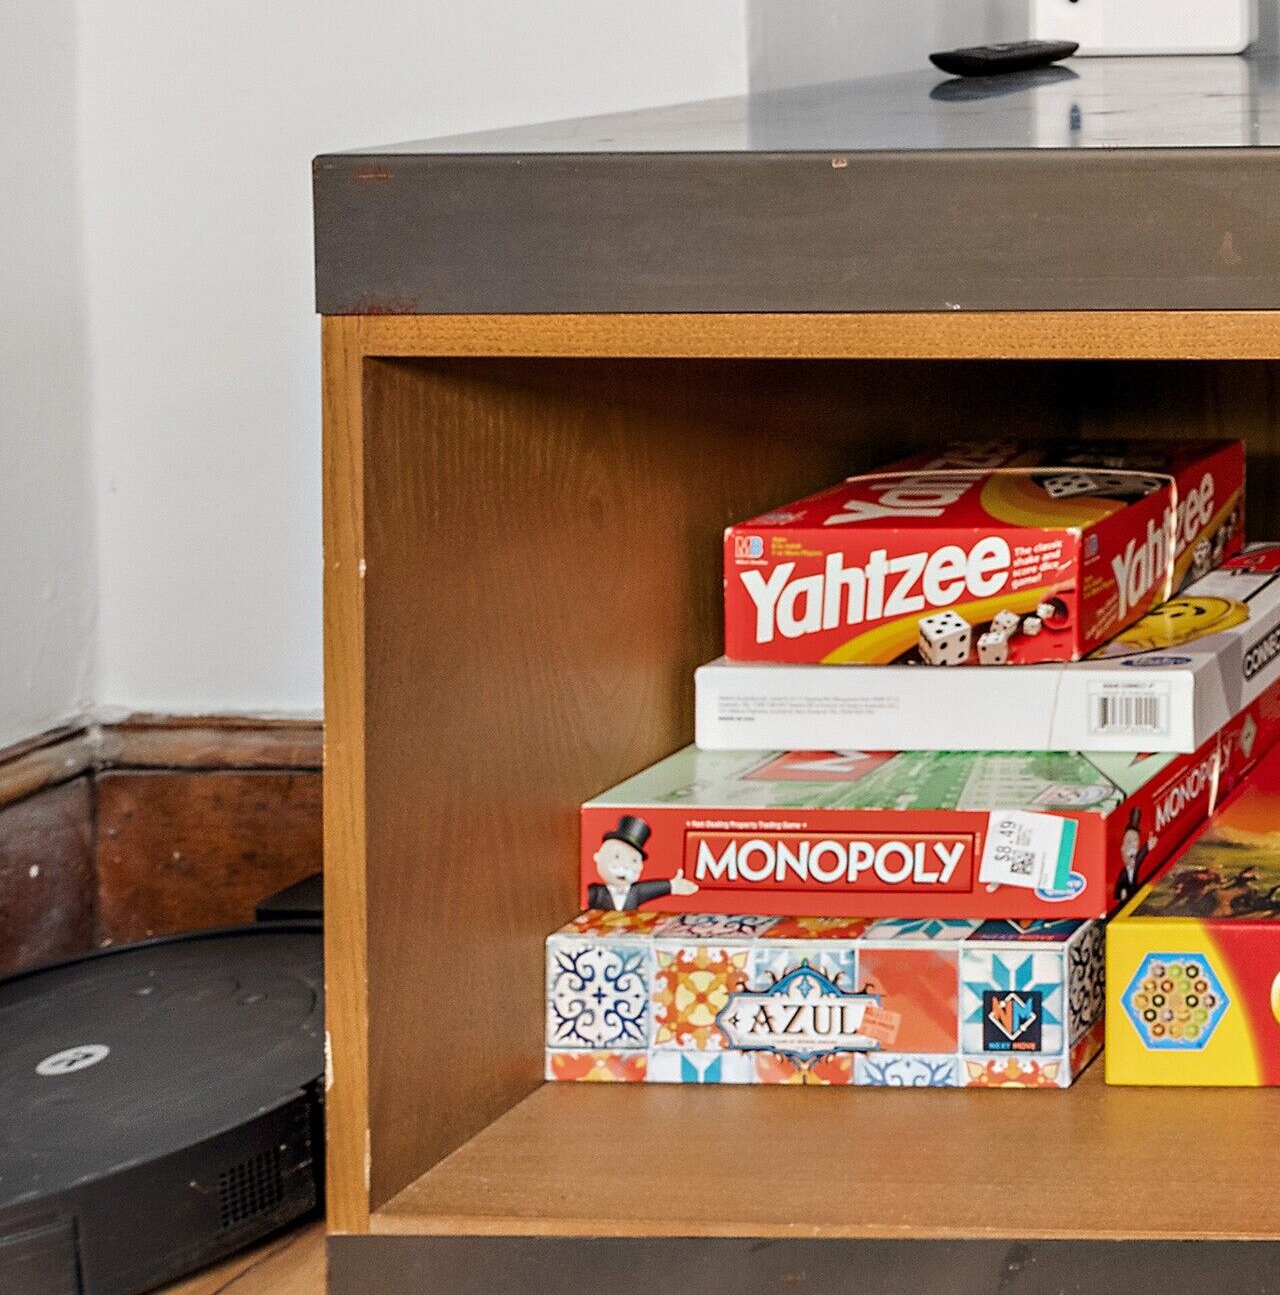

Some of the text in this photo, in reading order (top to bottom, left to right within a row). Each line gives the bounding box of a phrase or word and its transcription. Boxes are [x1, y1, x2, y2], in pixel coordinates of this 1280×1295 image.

[1012, 549, 1061, 567] shake and
[1014, 539, 1063, 556] The classic
[1012, 565, 1038, 578] score
[739, 536, 1011, 643] Yahtzee
[993, 820, 1017, 861] $8.49
[695, 838, 966, 884] MONOPOLY
[749, 1005, 858, 1035] AZUL
